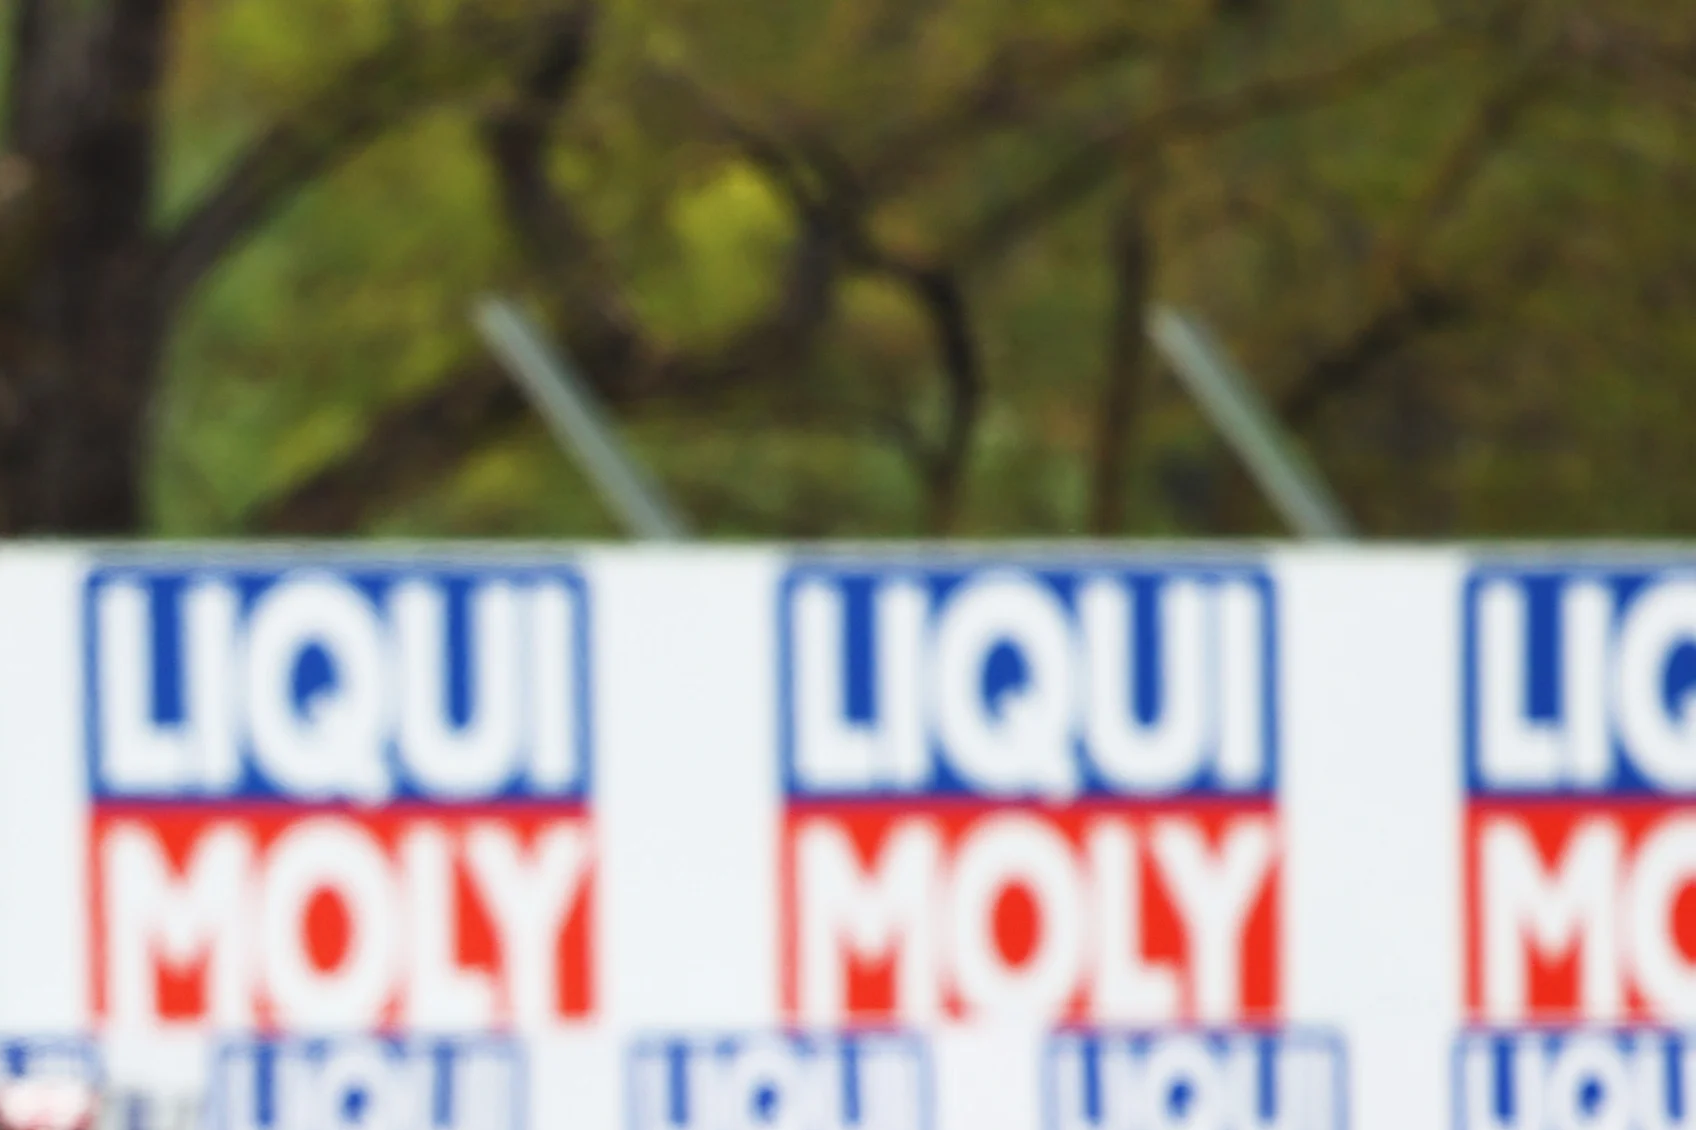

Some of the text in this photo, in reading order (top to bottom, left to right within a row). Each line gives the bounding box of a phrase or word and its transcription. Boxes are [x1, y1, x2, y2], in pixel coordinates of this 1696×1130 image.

[100, 570, 577, 806] LIQUI
[793, 568, 1262, 803] LIQUI
[105, 814, 592, 1030] MOLY
[798, 812, 1277, 1028] MOLY
